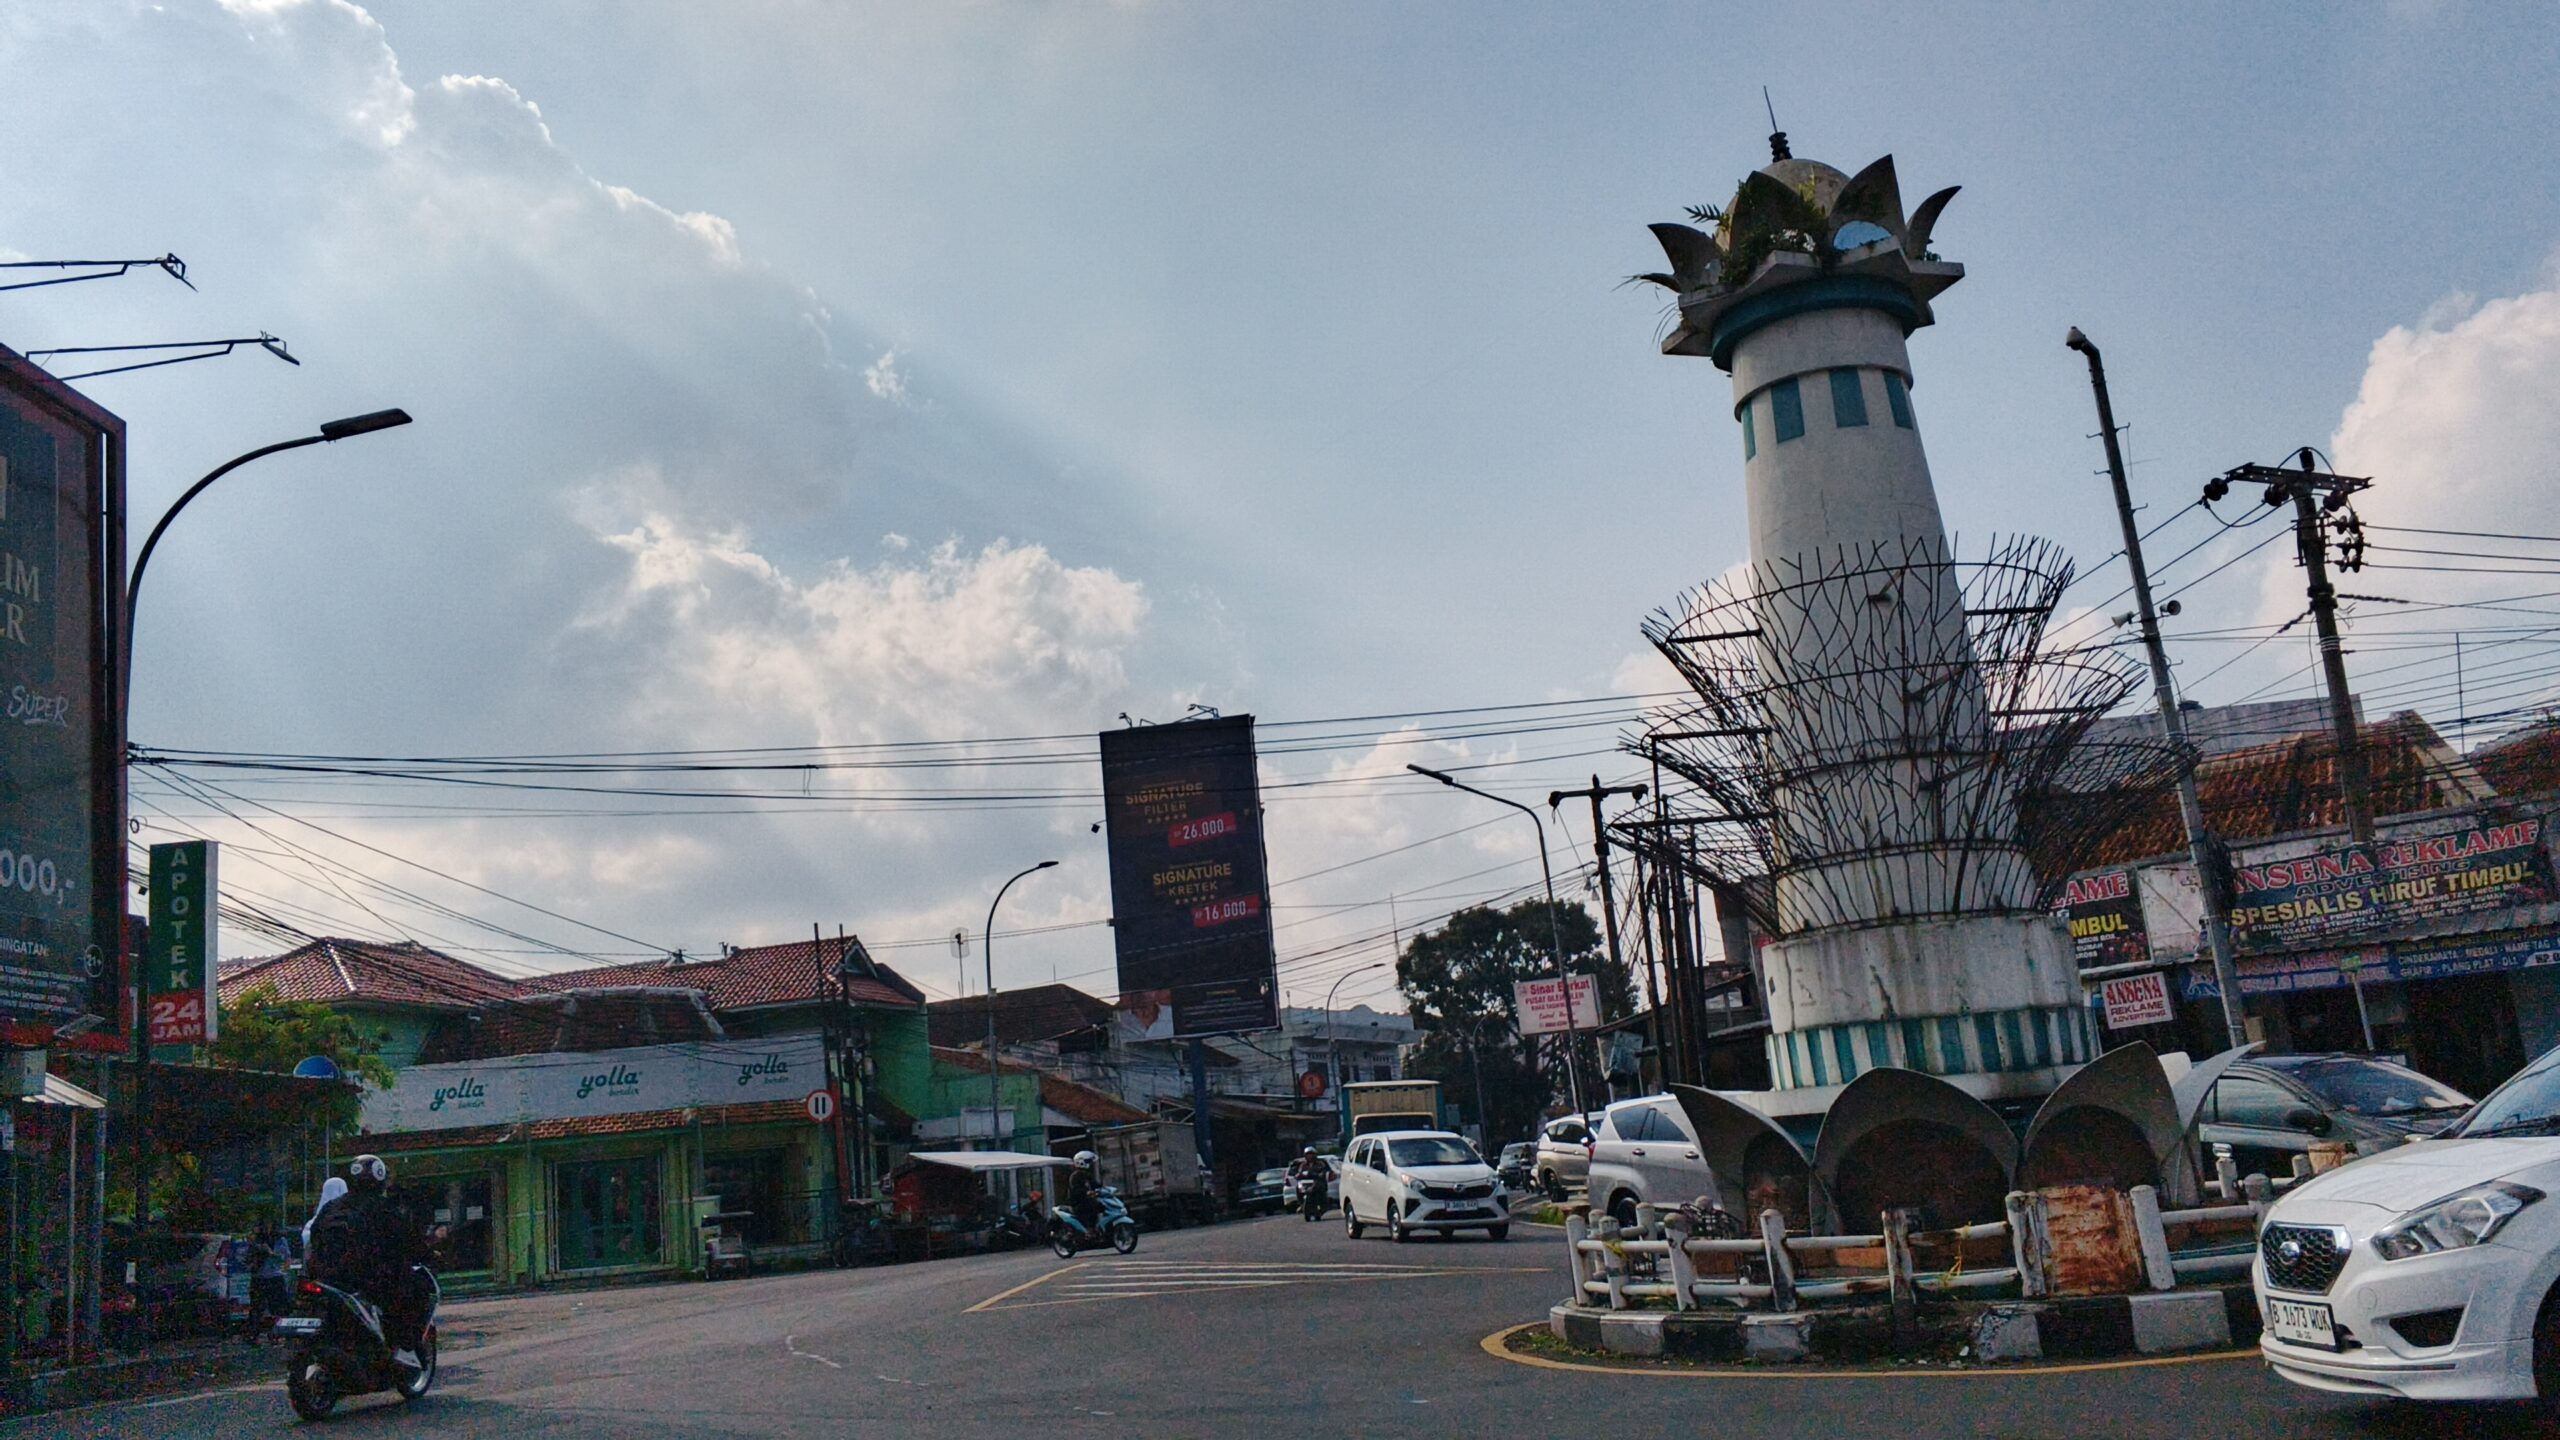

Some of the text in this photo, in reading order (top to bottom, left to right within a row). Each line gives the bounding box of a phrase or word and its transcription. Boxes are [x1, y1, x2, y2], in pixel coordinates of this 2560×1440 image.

[0, 551, 39, 602] IM
[0, 603, 28, 645] R
[1125, 782, 1204, 805] SIGNATURE
[1144, 801, 1187, 816] FILTER
[1183, 818, 1224, 840] 26.000
[2375, 819, 2540, 870] REKLAME
[1152, 862, 1232, 886] SIGNATURE
[1168, 880, 1218, 896] KRETEK
[2231, 891, 2362, 927] SPESIALIS
[2444, 861, 2535, 892] TIMBUL
[170, 848, 190, 989] APOTEK
[1204, 900, 1246, 921] 16.000
[2070, 913, 2129, 938] MBUL
[1530, 979, 1591, 995] Sinar Brkat
[2106, 976, 2163, 1005] ANSENA
[152, 998, 201, 1024] 24
[2111, 1001, 2164, 1016] REKLAME
[153, 1023, 202, 1039] JAM
[577, 1064, 639, 1099] yolla
[738, 1053, 788, 1086] yolla
[430, 1077, 485, 1111] yolla
[2271, 1303, 2280, 1323] B
